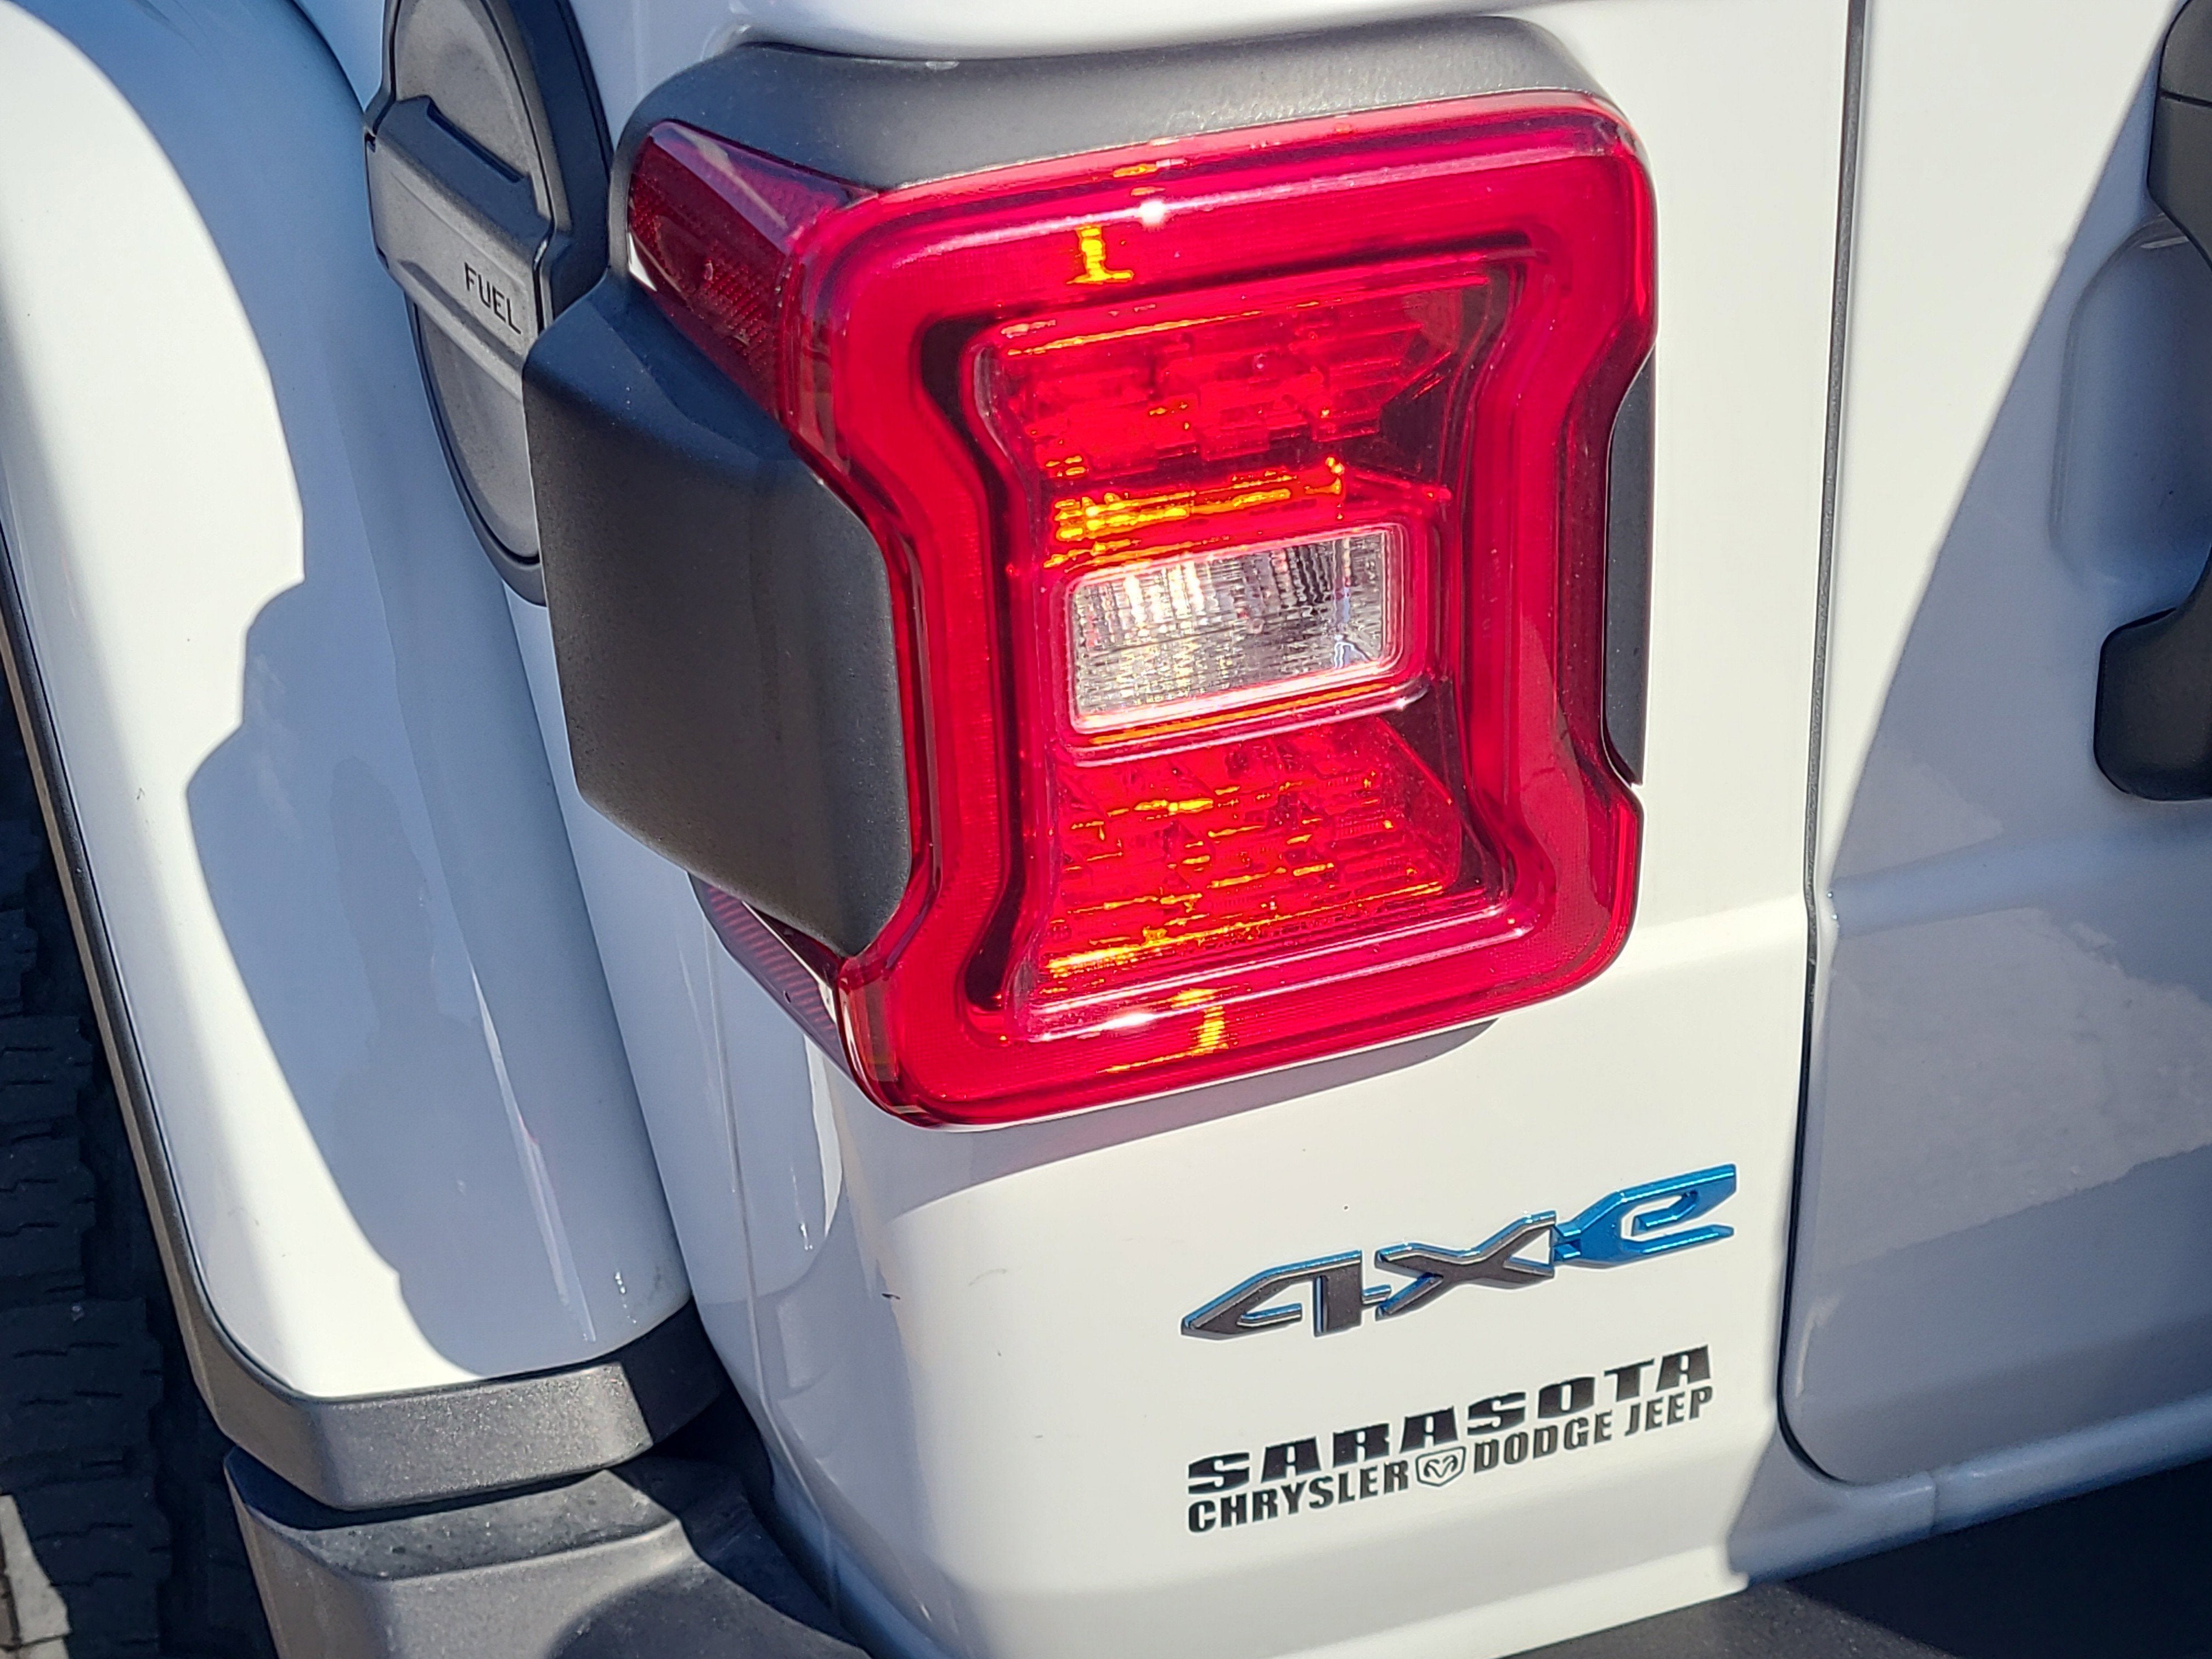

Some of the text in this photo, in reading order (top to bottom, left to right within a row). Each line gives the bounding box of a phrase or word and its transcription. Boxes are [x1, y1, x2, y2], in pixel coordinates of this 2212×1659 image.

[465, 262, 521, 335] FUEL
[1188, 1344, 1712, 1494] SARASOTA
[1188, 1385, 1713, 1532] CHRYSLER DODGE JEEP
